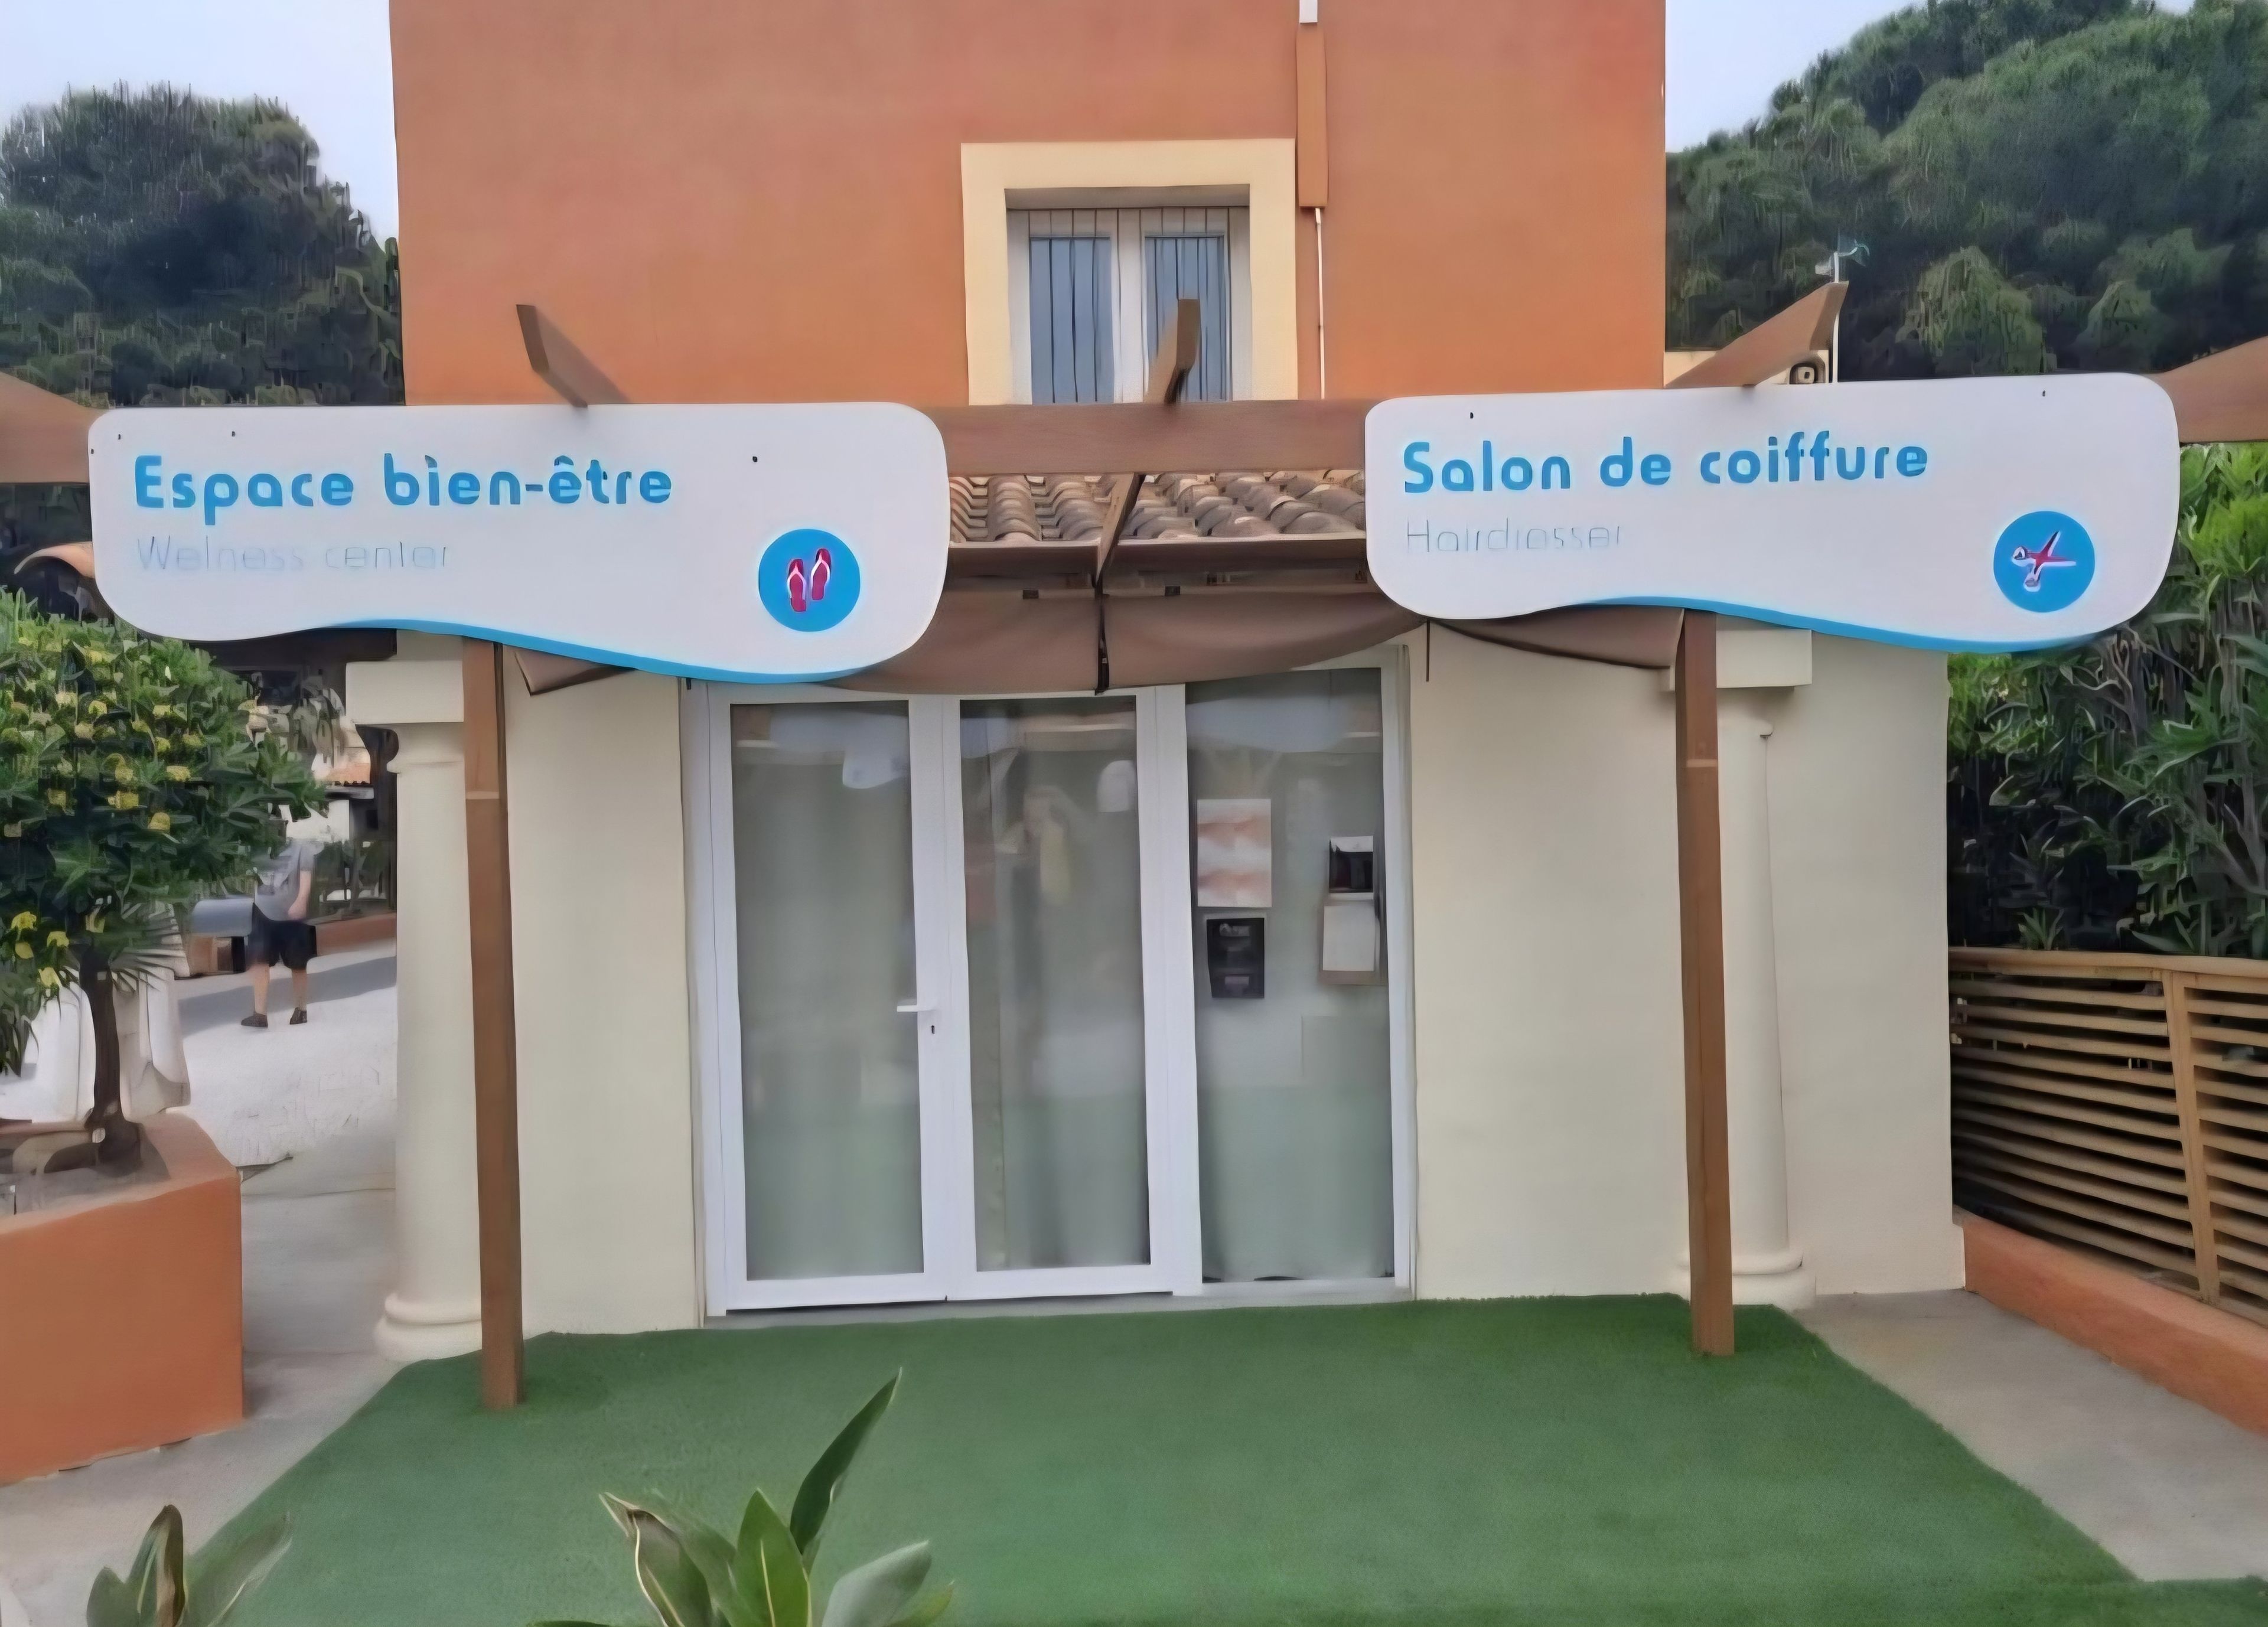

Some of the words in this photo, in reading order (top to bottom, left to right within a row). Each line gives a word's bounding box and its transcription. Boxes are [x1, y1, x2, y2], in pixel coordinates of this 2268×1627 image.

[135, 455, 354, 526] Espace
[384, 453, 672, 506] bien-être
[1403, 440, 1571, 494] Salon
[1600, 436, 1671, 487] de
[1700, 431, 1928, 484] coiffure
